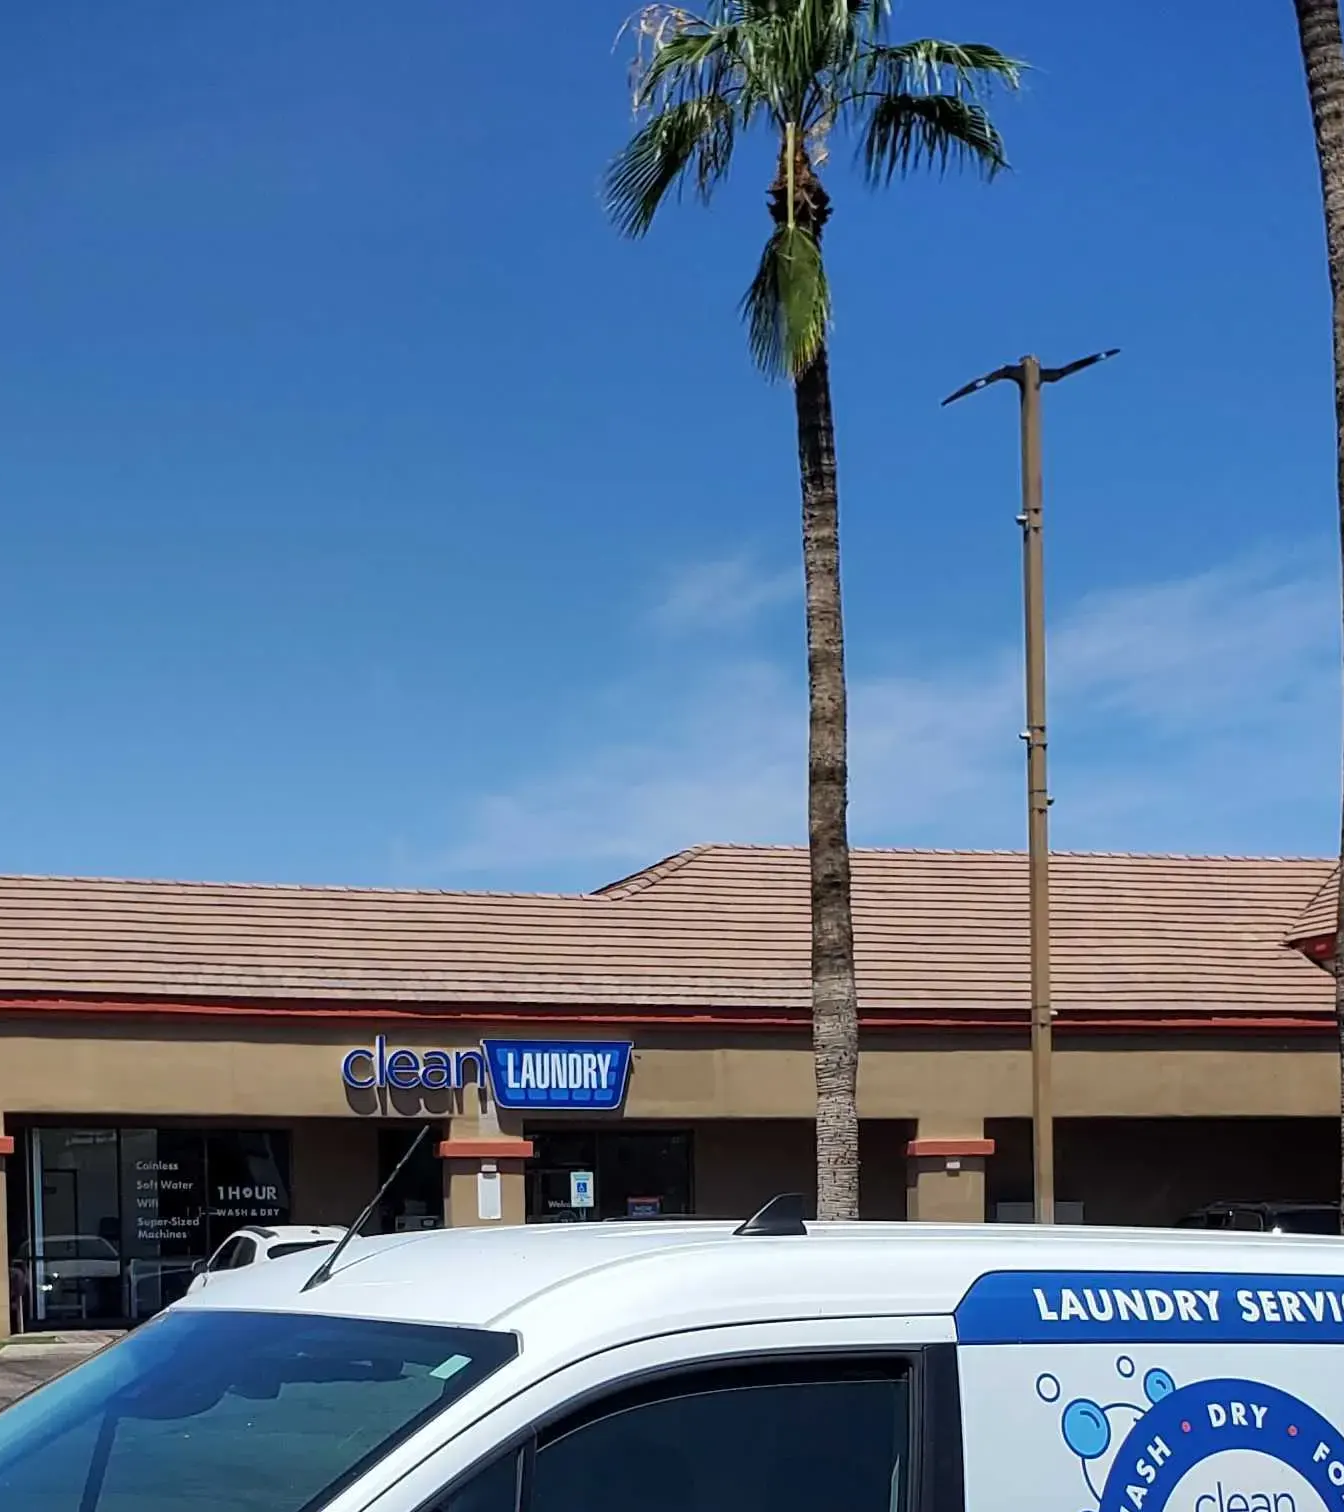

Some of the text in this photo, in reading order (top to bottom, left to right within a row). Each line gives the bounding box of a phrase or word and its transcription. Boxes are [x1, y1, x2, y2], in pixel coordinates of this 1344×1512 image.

[342, 1035, 612, 1089] clean LAUNDRY
[136, 1161, 179, 1171] Coinless
[136, 1180, 194, 1190] Soft Water
[217, 1209, 248, 1217] WASH
[260, 1208, 280, 1217] DRY
[137, 1216, 200, 1227] Super-Sized
[138, 1229, 187, 1239] Machines
[1033, 1288, 1220, 1322] LAUNDRY
[1207, 1401, 1268, 1429] DRY
